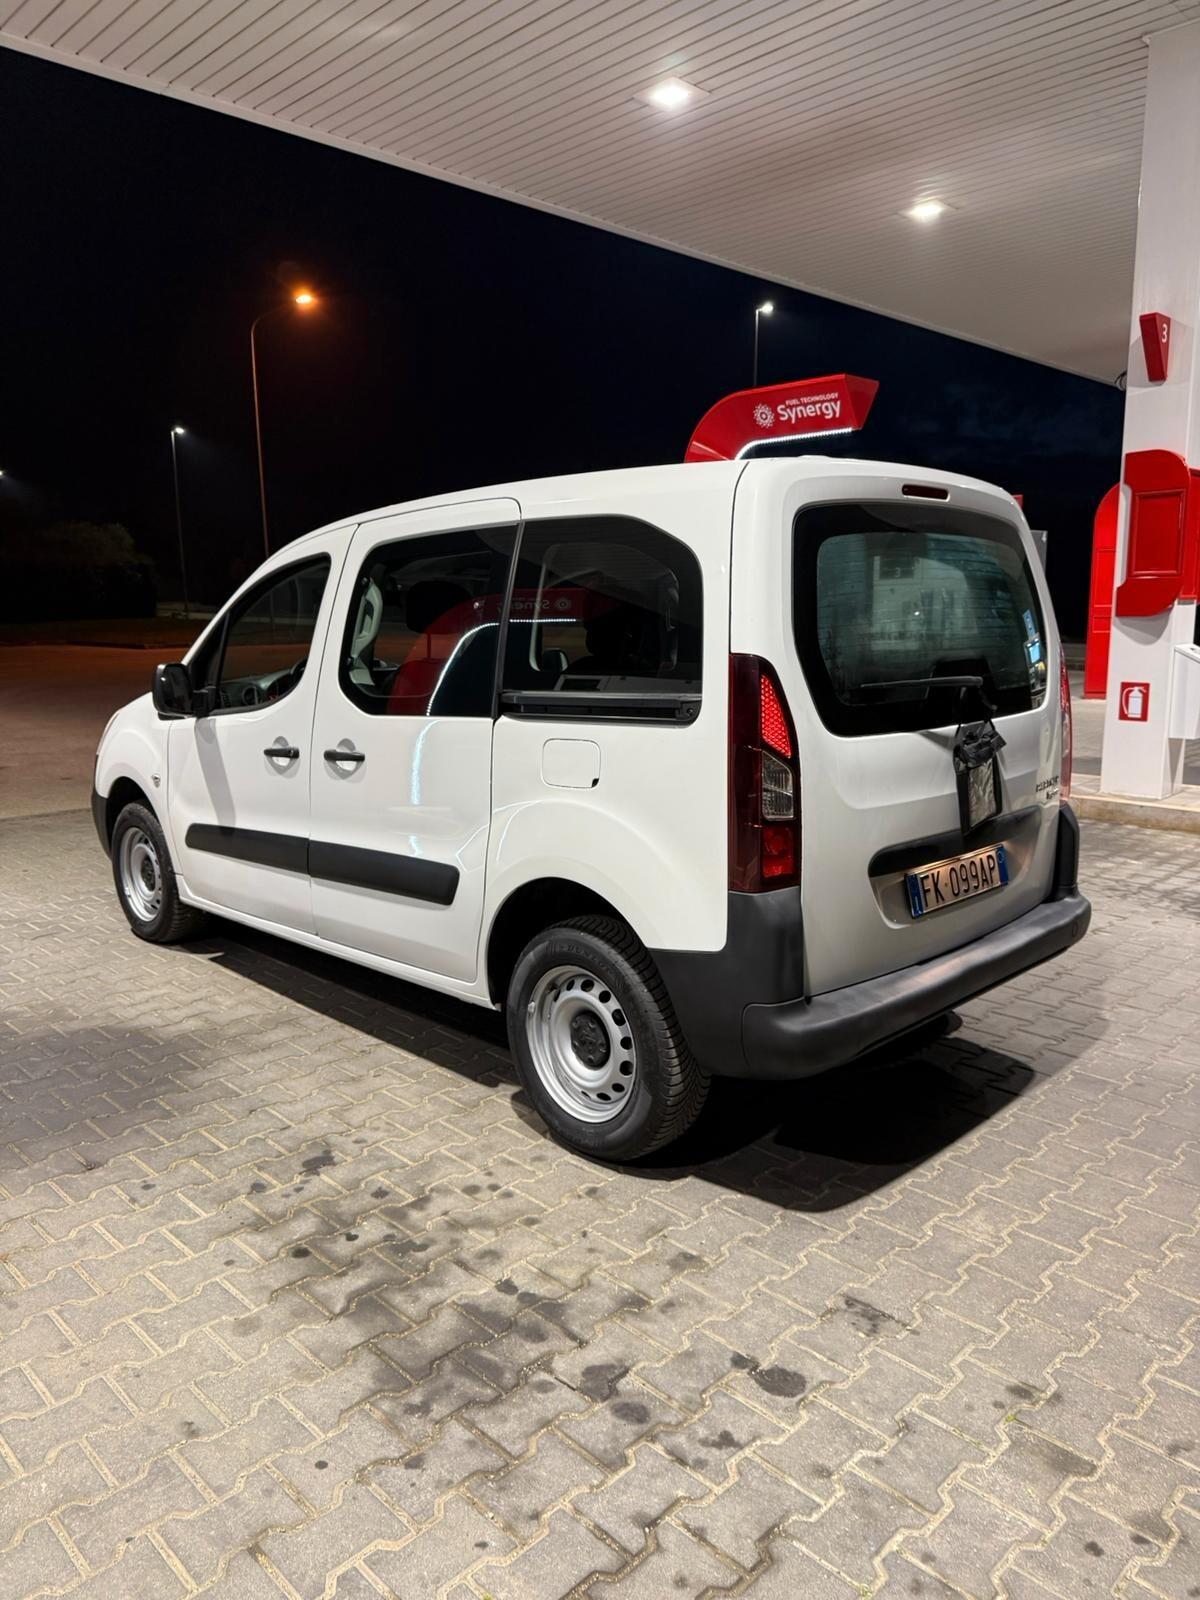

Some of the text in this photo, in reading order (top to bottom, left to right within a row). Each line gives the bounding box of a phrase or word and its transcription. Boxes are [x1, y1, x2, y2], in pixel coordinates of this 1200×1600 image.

[1161, 323, 1168, 343] 3
[785, 392, 839, 406] FUEL TECHNOLOGY
[777, 400, 841, 424] Synergy
[920, 854, 995, 908] FK 099AP
